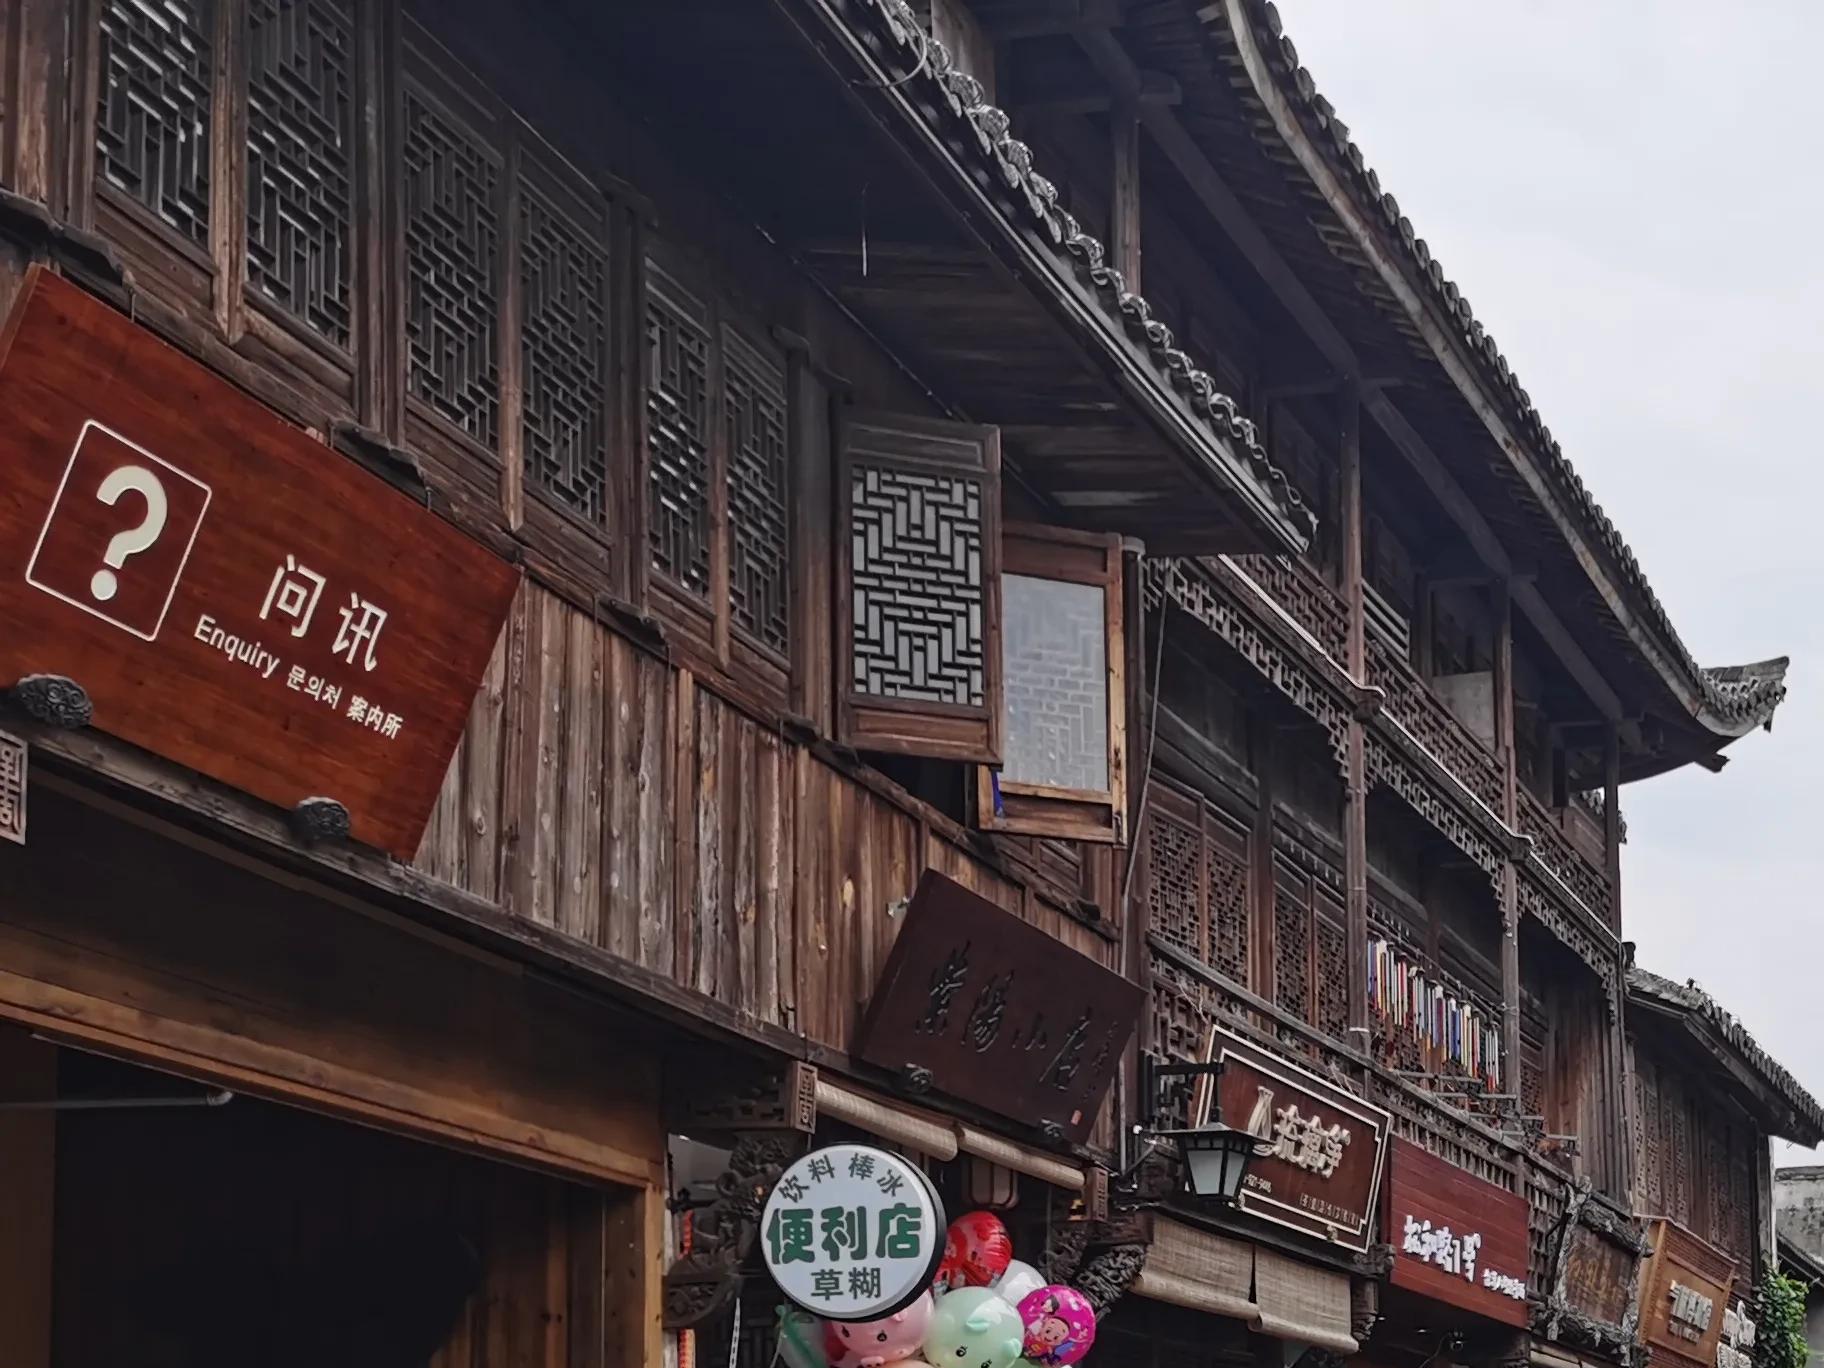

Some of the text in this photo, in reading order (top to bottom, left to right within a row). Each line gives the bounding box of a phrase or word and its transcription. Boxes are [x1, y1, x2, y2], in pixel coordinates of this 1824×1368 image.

[258, 554, 388, 672] 问讯
[194, 614, 403, 739] Enquiry 문의처 案内所
[765, 1202, 922, 1265] 便利店
[810, 1266, 882, 1301] 草糊
